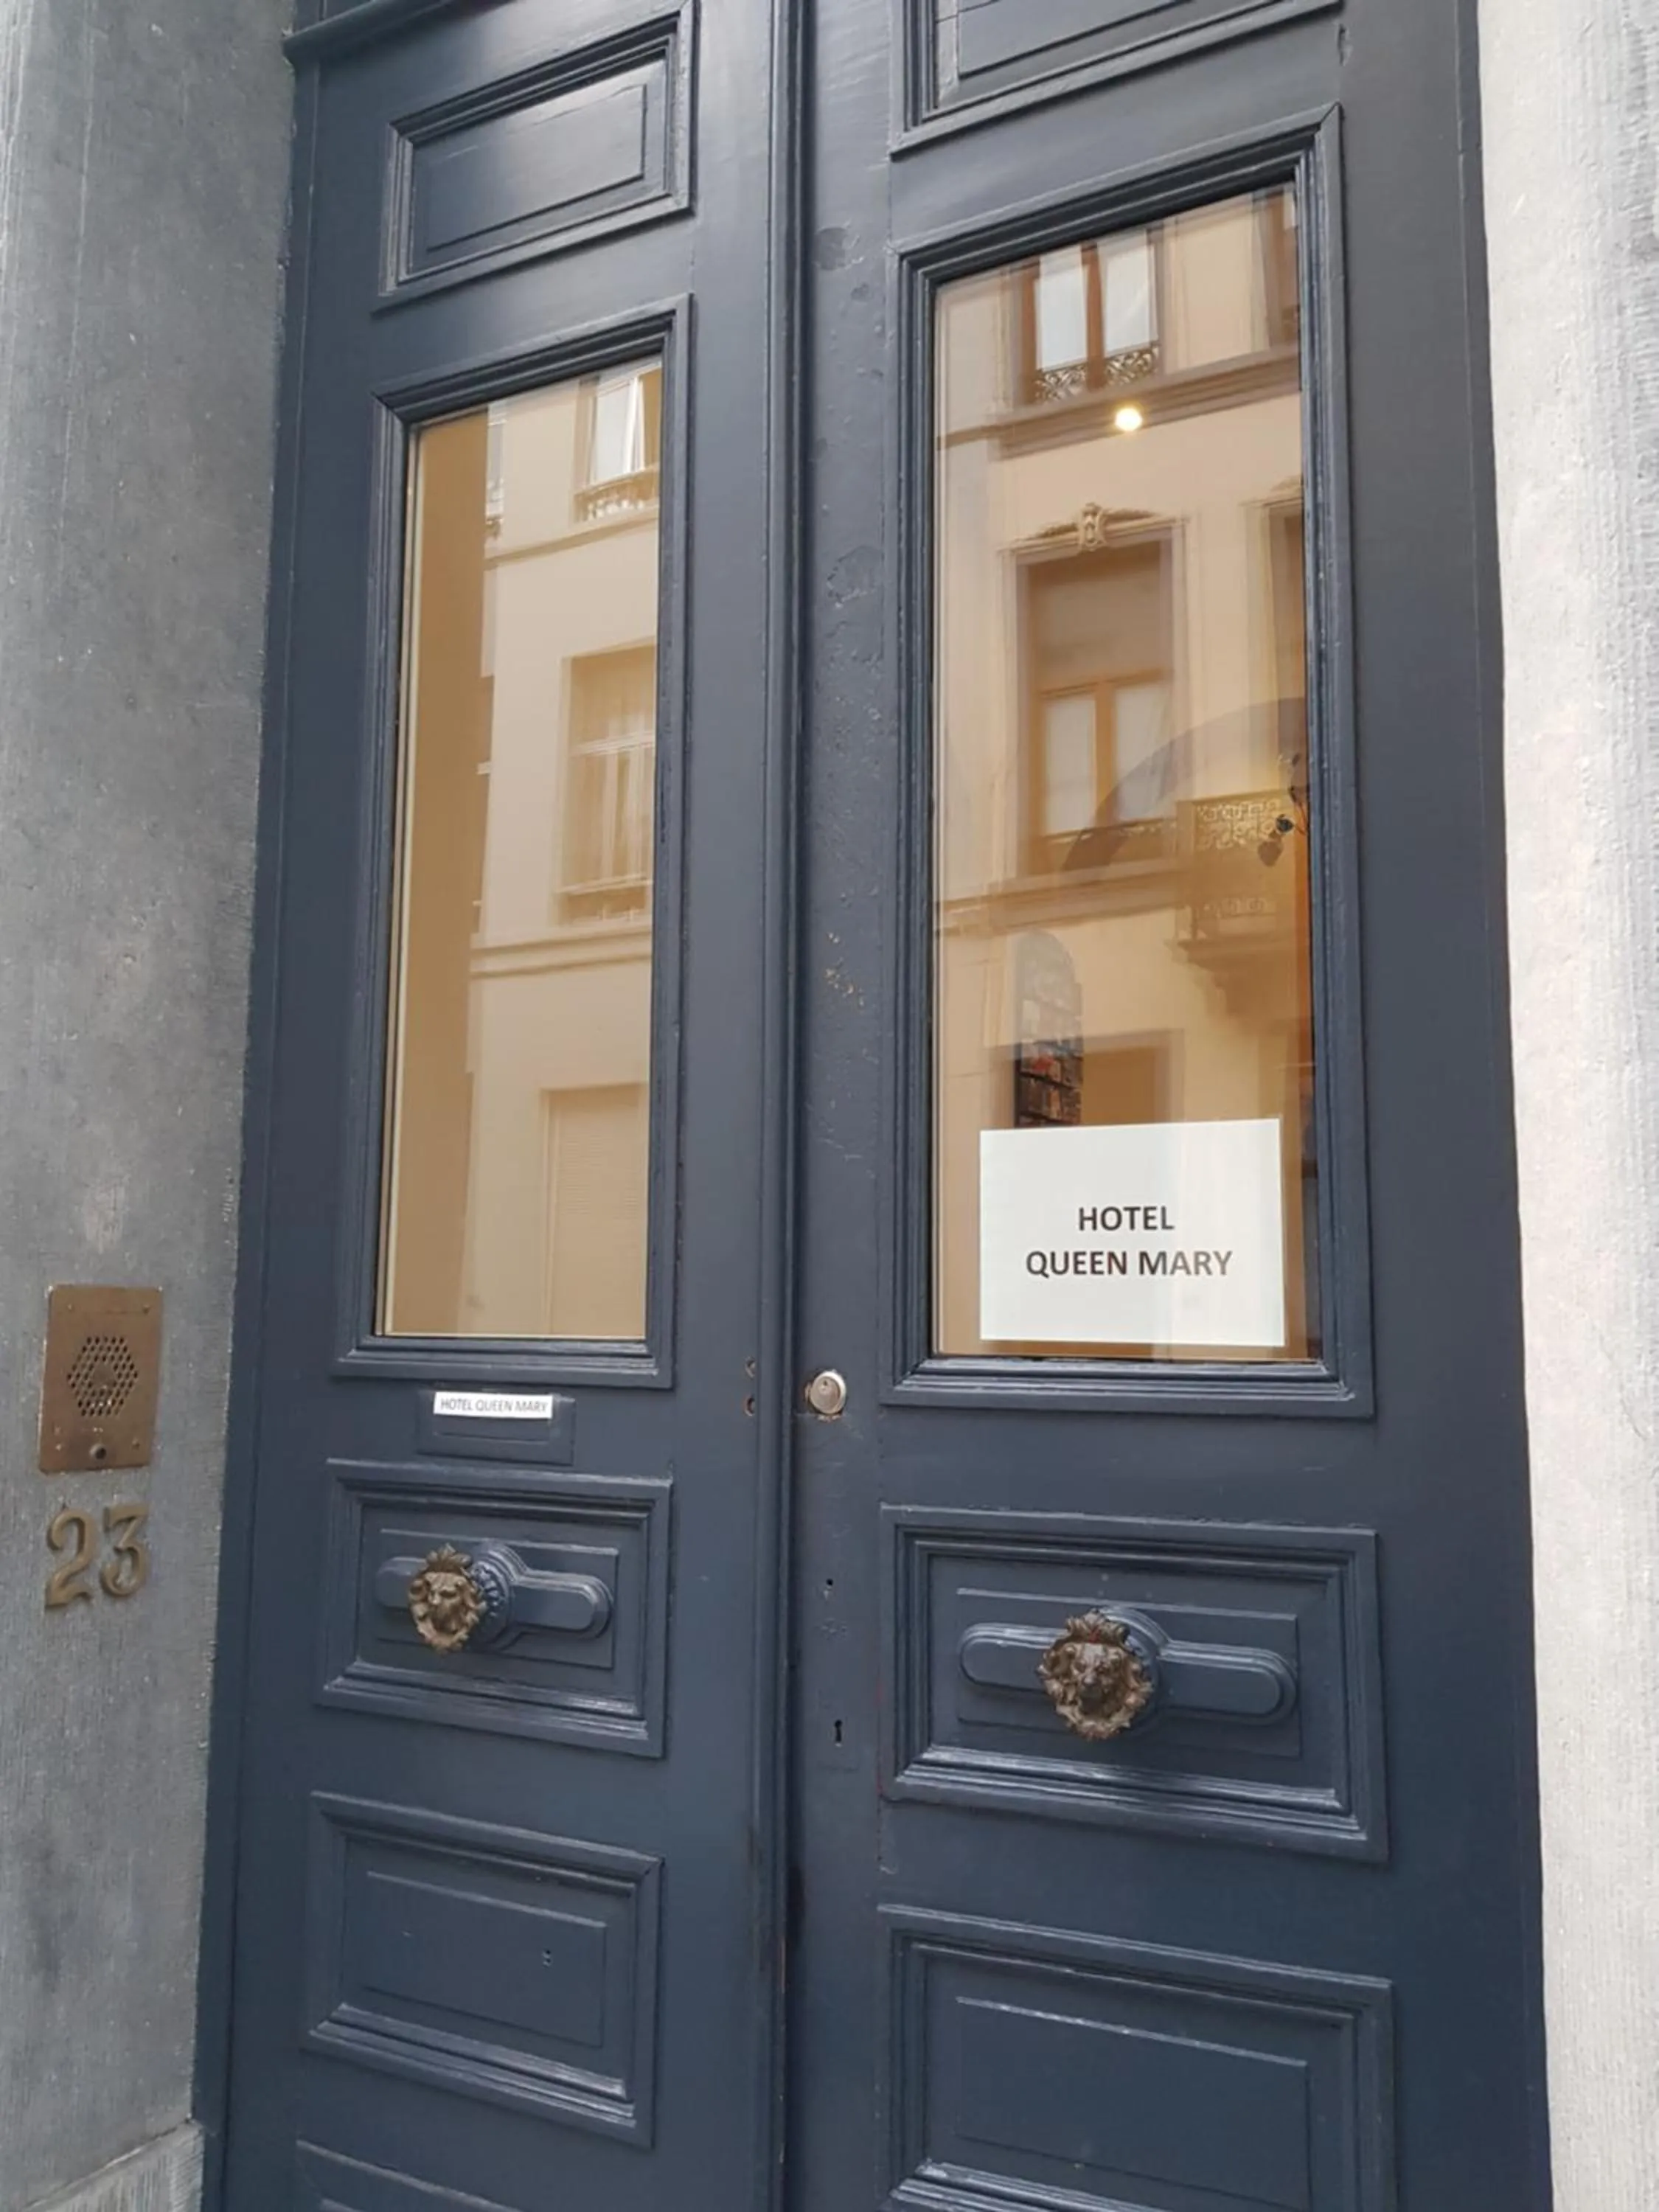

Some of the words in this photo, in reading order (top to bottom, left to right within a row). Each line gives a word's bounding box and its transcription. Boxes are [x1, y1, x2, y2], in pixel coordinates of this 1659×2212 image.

[1078, 1206, 1175, 1231] HOTEL
[1026, 1251, 1128, 1279] QUEEN
[1138, 1250, 1233, 1276] MARY
[440, 1397, 473, 1411] HOTEL
[475, 1399, 512, 1413] QUEEN
[515, 1400, 549, 1413] MARY
[44, 1503, 150, 1610] 23
